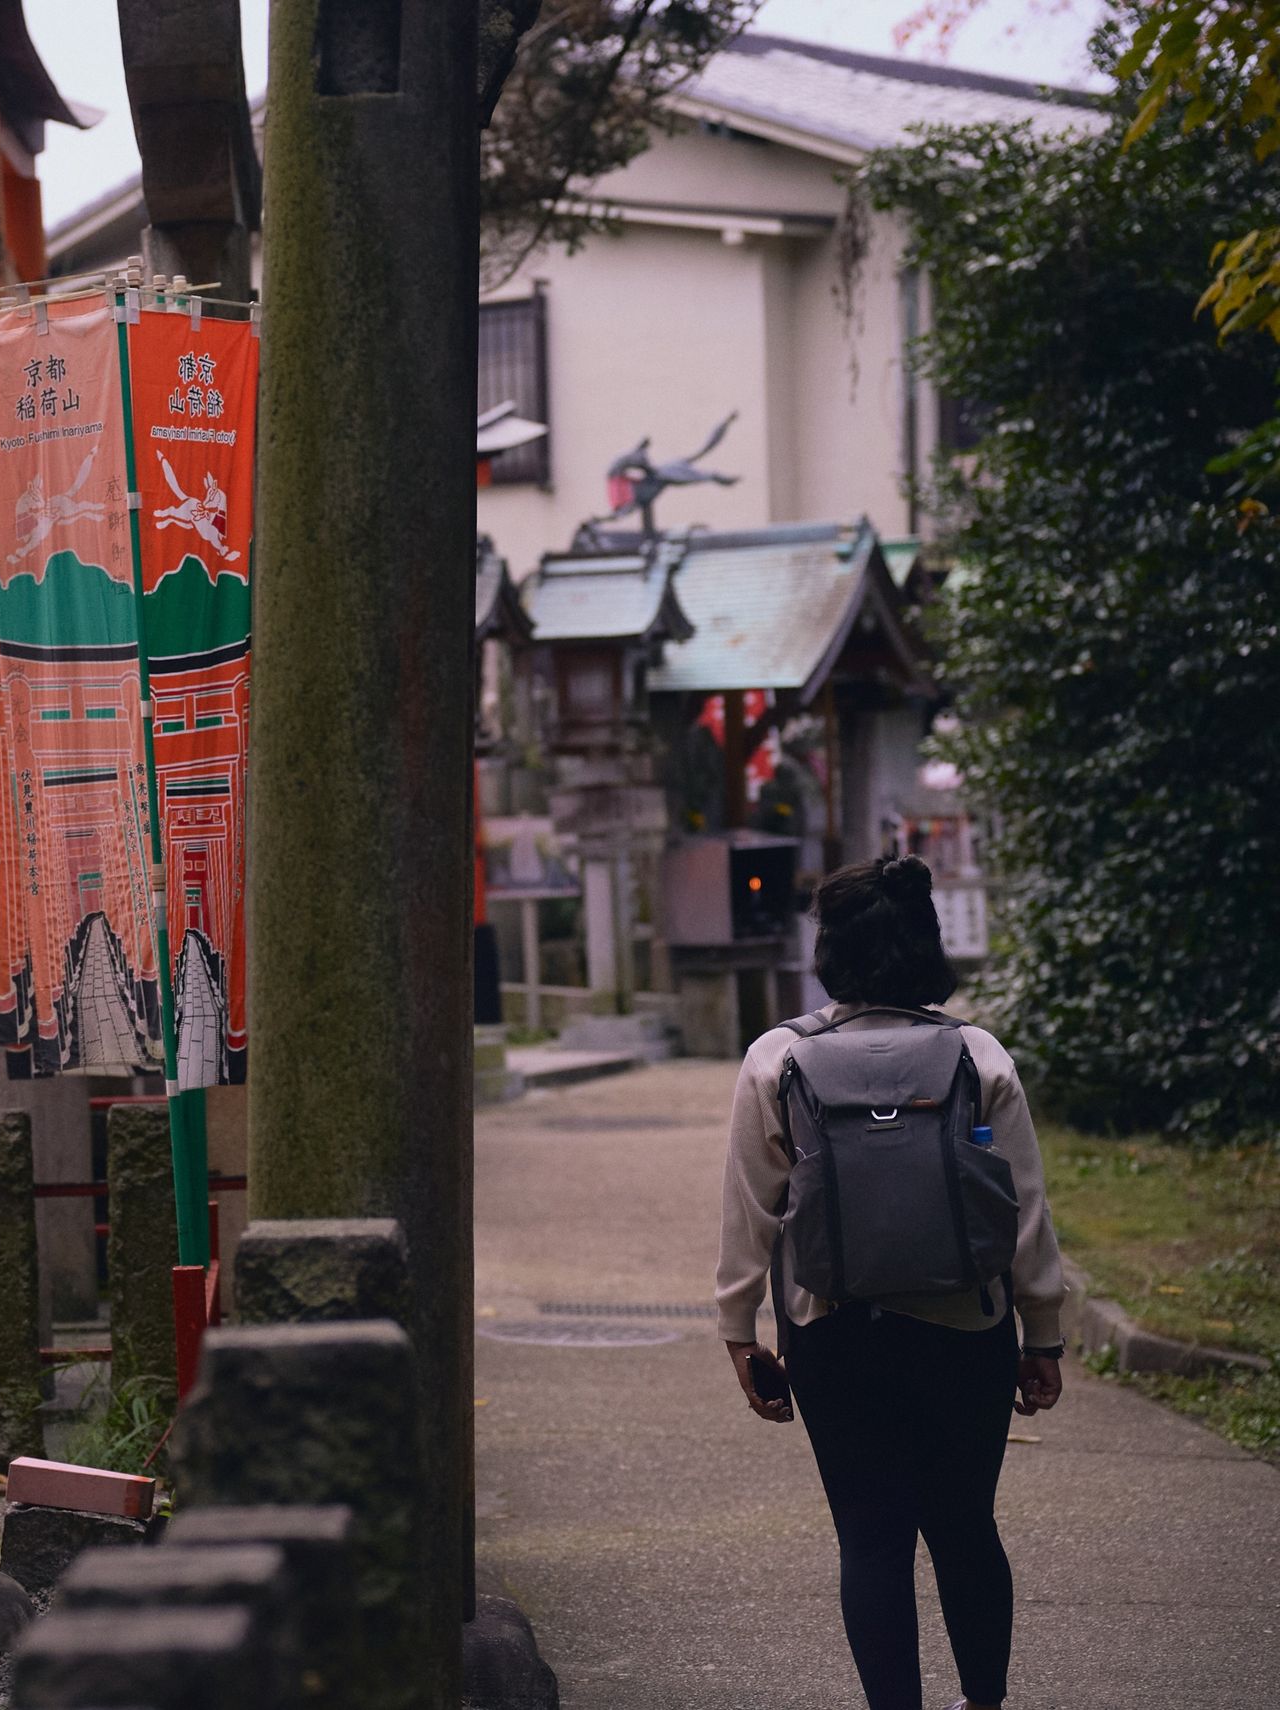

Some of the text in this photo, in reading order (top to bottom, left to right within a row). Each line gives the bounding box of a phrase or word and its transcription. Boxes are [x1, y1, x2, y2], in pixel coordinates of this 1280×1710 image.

[24, 355, 66, 387] 京都
[16, 387, 80, 420] 稲荷山
[0, 422, 103, 451] Kyoto Fushimi Inariyama
